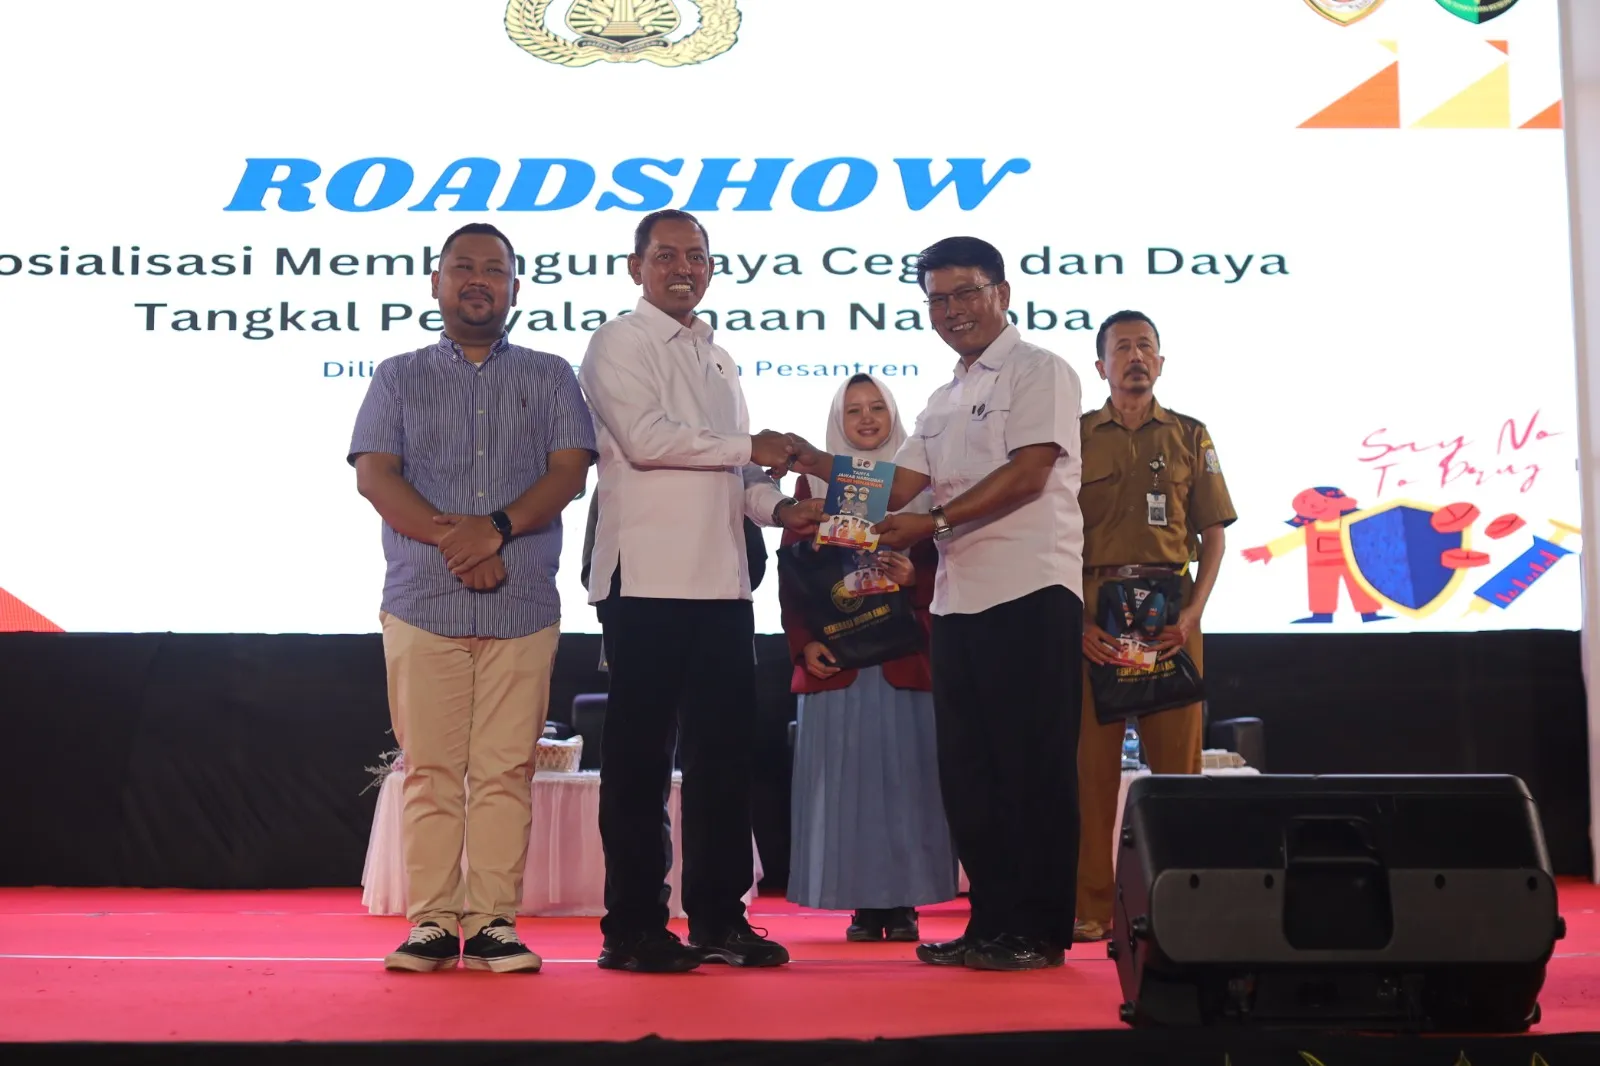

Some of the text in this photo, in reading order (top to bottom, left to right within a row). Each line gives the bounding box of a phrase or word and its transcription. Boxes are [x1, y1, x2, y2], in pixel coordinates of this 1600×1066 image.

[223, 156, 1032, 213] ROADSHOW
[0, 246, 253, 276] osialisasi
[712, 253, 803, 285] aya
[1020, 245, 1124, 276] dan
[1147, 247, 1290, 284] Daya
[134, 301, 360, 341] Tangkal
[757, 360, 919, 378] Pesantren
[1497, 408, 1566, 455] No
[1372, 462, 1419, 498] To
